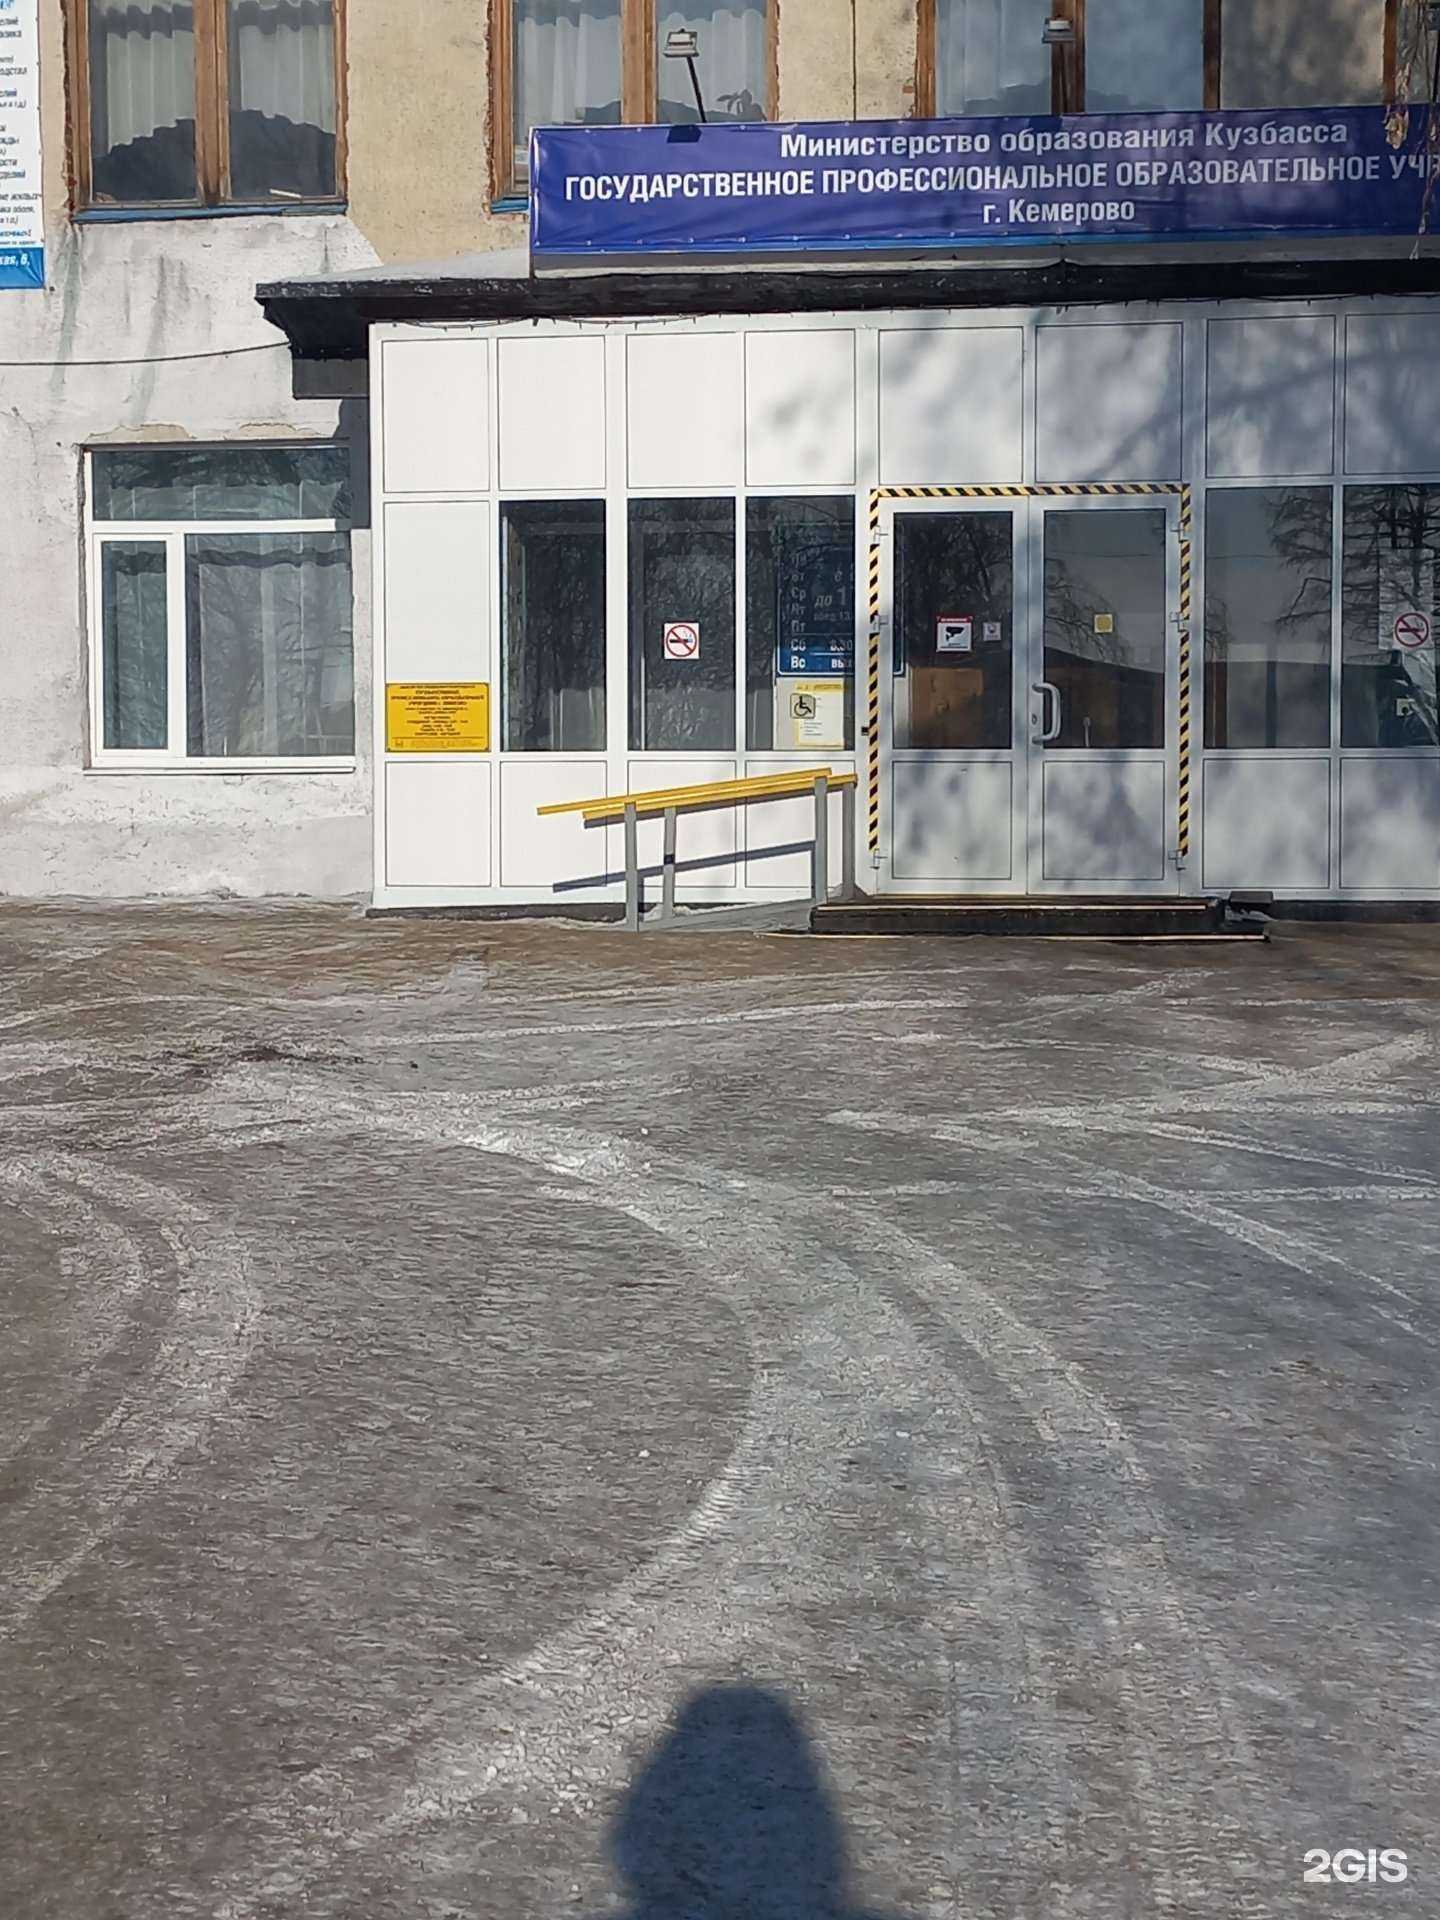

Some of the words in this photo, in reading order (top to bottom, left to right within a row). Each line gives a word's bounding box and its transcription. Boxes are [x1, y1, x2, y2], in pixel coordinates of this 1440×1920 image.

[780, 132, 990, 158] Министерство
[1000, 127, 1195, 155] образования
[1205, 120, 1348, 151] Кузбасса
[564, 168, 814, 203] ГОСУДАРСТВЕННОЕ
[822, 160, 1106, 194] ПРОФЕССИОНАЛЬНОЕ
[1116, 154, 1380, 186] ОБРАЗОВАТЕЛЬНОЕ
[982, 203, 1001, 224] г.
[1008, 198, 1136, 226] Кемерово
[814, 595, 833, 609] до
[790, 655, 807, 669] Вс
